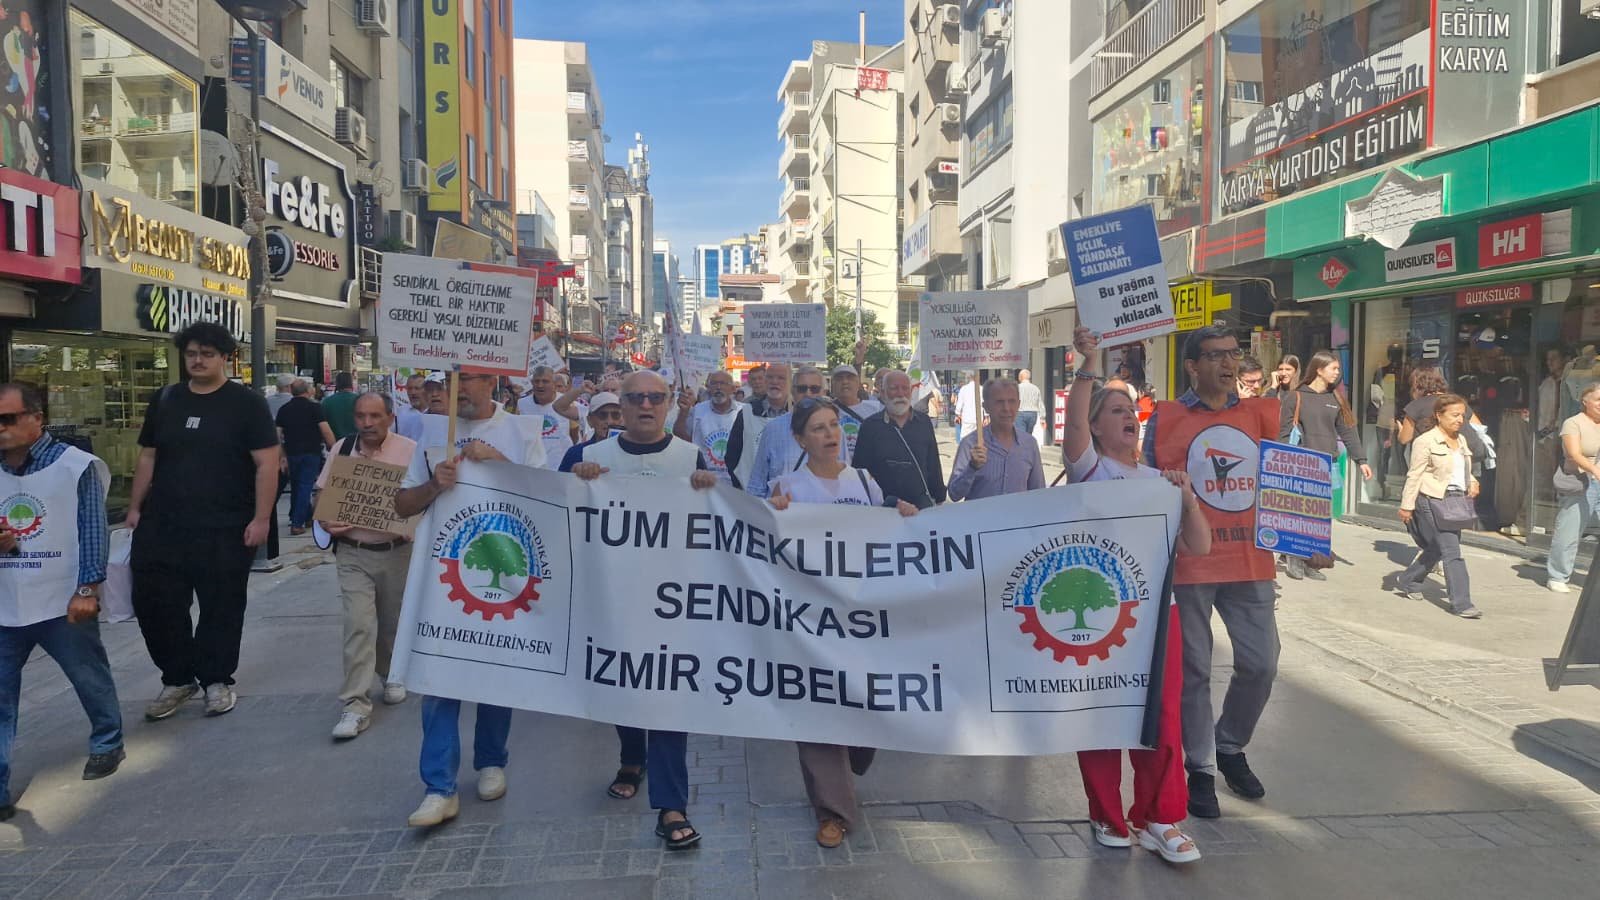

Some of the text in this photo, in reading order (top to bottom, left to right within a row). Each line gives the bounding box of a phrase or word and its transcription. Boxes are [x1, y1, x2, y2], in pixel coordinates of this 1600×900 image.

[1440, 8, 1510, 38] EĞİTİM
[1440, 47, 1509, 72] KARYA
[292, 70, 324, 110] VENUS
[1221, 105, 1424, 208] KARYA YURTDIŞI EĞİTİM
[265, 157, 345, 239] Fe&Fe
[363, 189, 374, 239] TATTOO
[132, 214, 194, 264] BEAUTY
[1073, 221, 1122, 241] EMEKLİYE
[1492, 226, 1526, 257] HH
[1079, 245, 1125, 265] YANDAŞA
[1081, 257, 1132, 278] SALTANAT!
[1387, 253, 1435, 271] QUIKSILVER
[393, 274, 512, 299] SENDİKAL ÖRGÜTLENME
[1098, 276, 1155, 300] Bu yağma
[1121, 288, 1159, 309] düzeni
[1465, 286, 1521, 305] QUIKSILVER
[409, 293, 505, 315] TEMEL BİR HAKTIR
[1171, 286, 1202, 315] YFEL
[389, 308, 519, 333] GEREKLİ YASAL DÜZENLEME
[1114, 304, 1163, 329] yıkılacak
[410, 327, 503, 347] HEMEN YAPILMALI
[931, 327, 973, 339] YASAKLARA
[1265, 461, 1294, 475] DAHA
[446, 500, 523, 532] EMEKLİLERİN
[522, 514, 552, 580] SENDİKASI
[576, 500, 975, 579] TÜM EMEKLİLERİN
[1002, 530, 1150, 611] TÜM EMEKLİLERİN SENDİKASI
[484, 591, 502, 600] 2017
[653, 581, 890, 639] SENDİKASI
[416, 621, 552, 656] TÜM EMEKLİLERİN-SEN
[1072, 633, 1091, 642] 2017
[585, 636, 943, 712] İZMİR ŞUBELERİ
[1005, 671, 1151, 694] TÜM EMEKLİLERİN-SE
